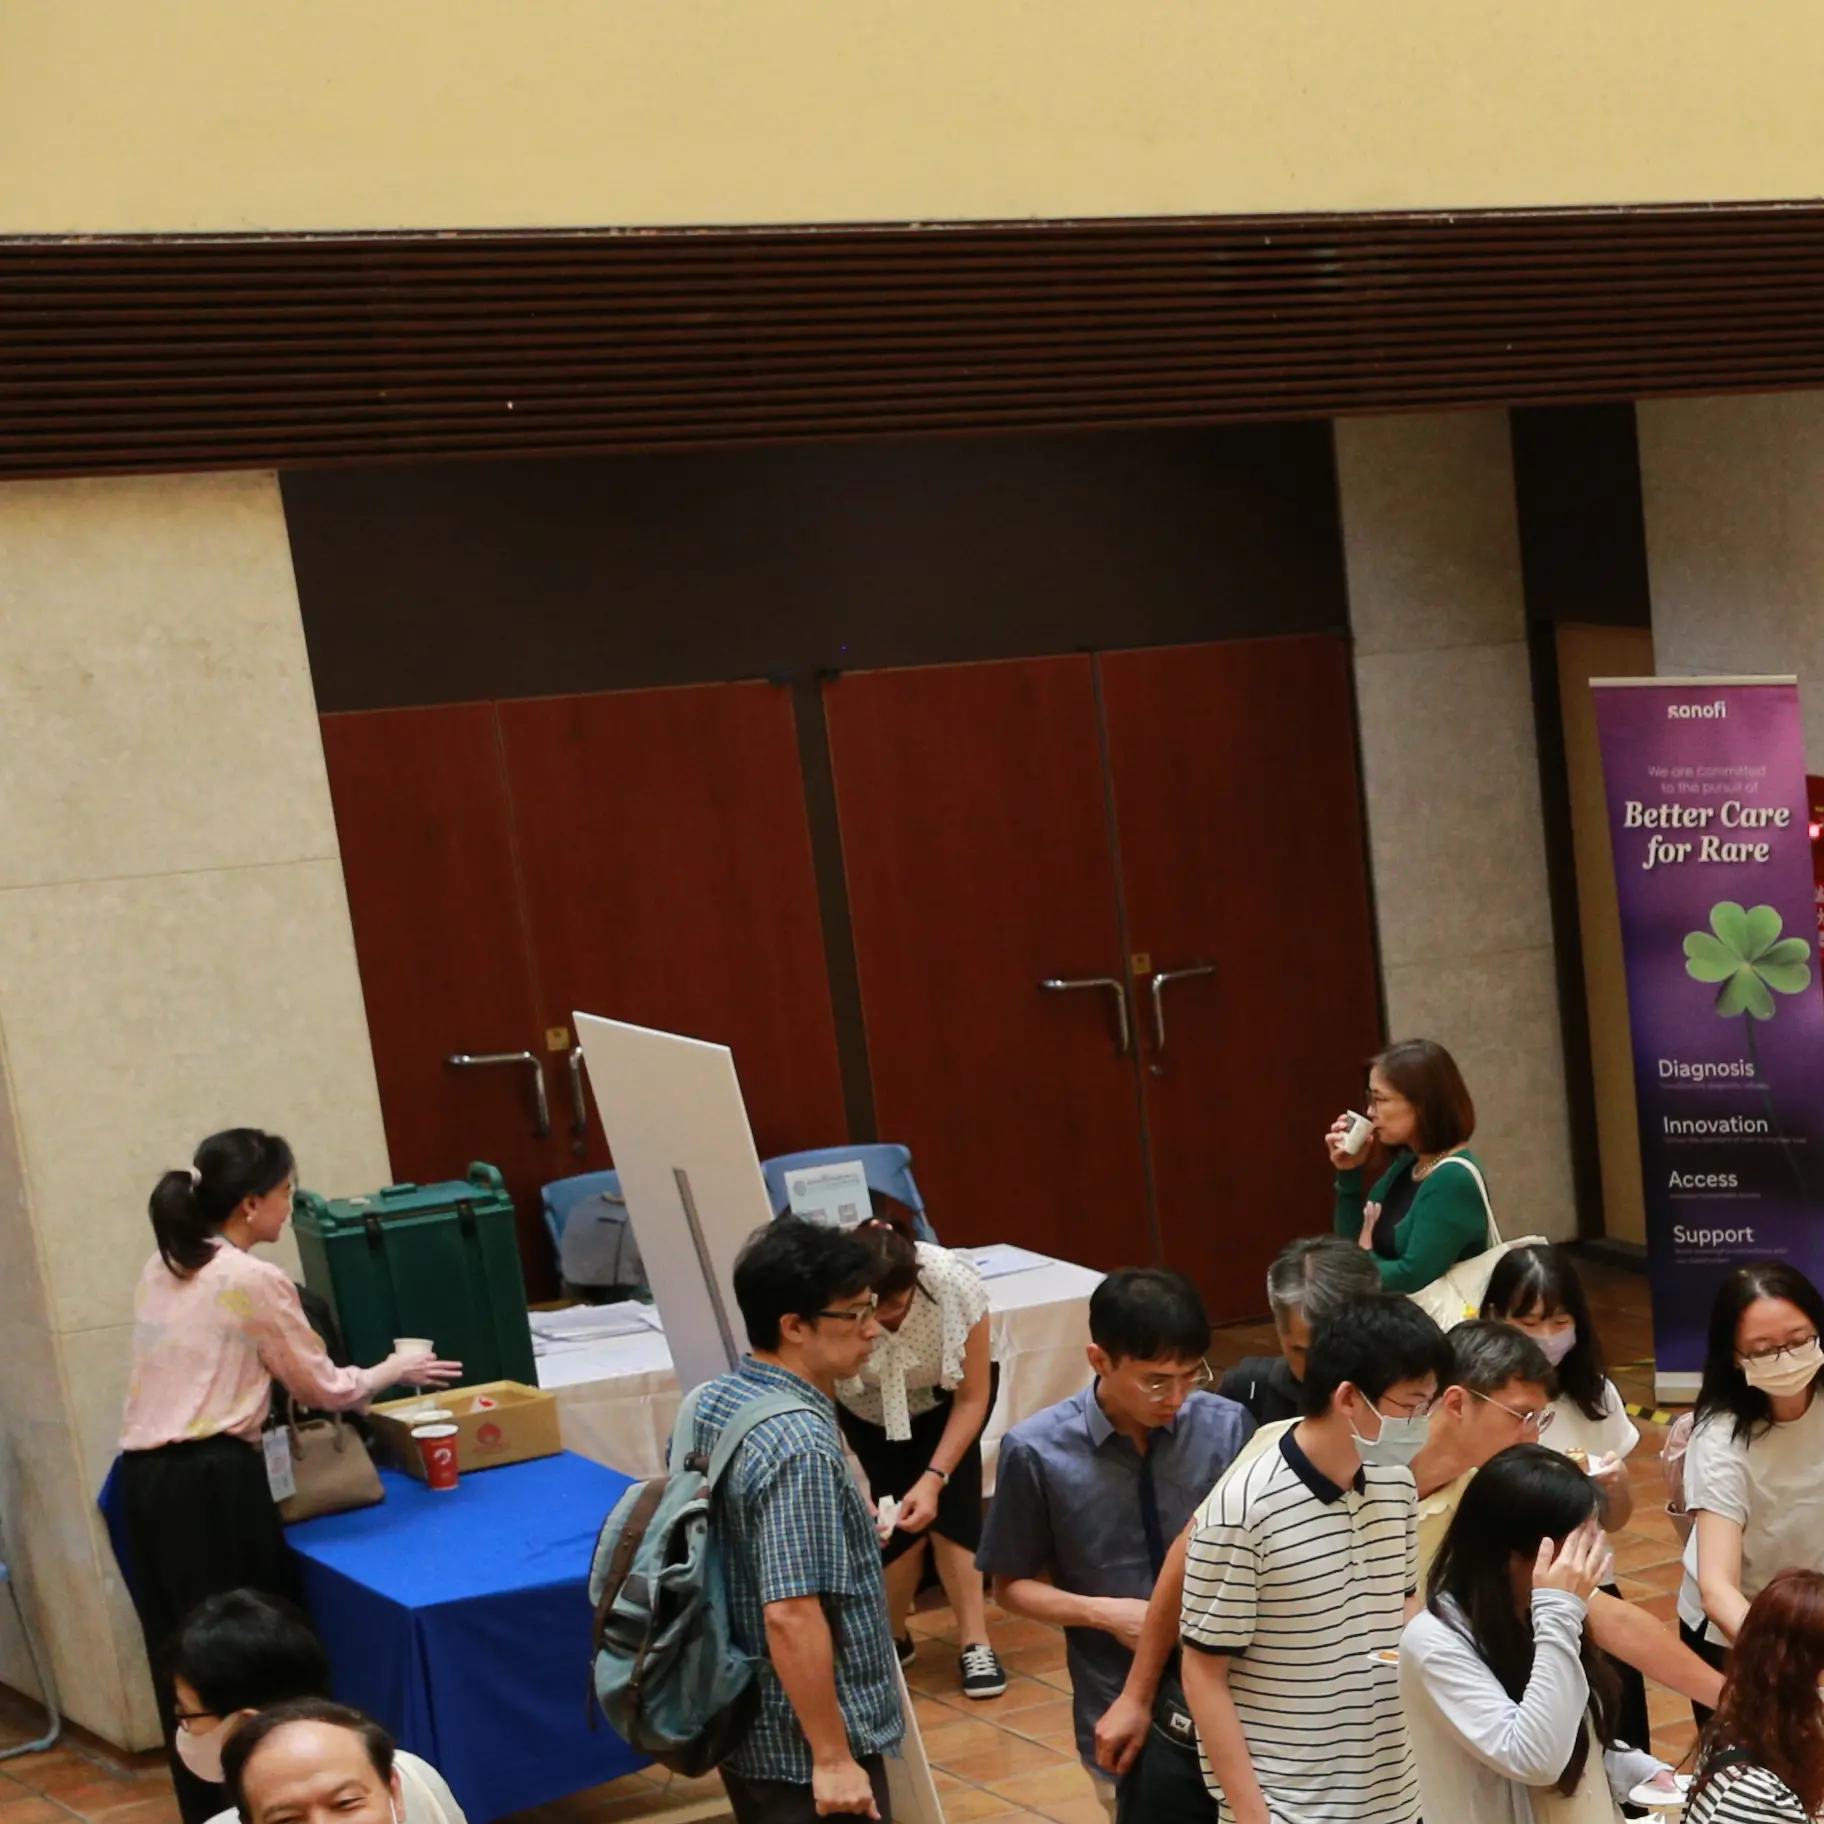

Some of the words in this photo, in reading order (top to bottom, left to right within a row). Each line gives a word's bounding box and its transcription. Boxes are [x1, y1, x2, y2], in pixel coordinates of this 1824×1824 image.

[1667, 700, 1727, 719] sanofi
[1648, 765, 1668, 778] We
[1671, 766, 1694, 778] are
[1697, 765, 1767, 778] committed
[1661, 782, 1675, 795] to
[1679, 781, 1700, 794] the
[1703, 781, 1742, 796] pursuit
[1745, 781, 1759, 794] of
[1623, 800, 1715, 829] Better
[1720, 800, 1791, 829] Care
[1642, 834, 1693, 871] for
[1698, 834, 1771, 863] Rare
[1657, 1058, 1756, 1082] Diagnosis
[1663, 1115, 1769, 1135] Innovation
[1668, 1170, 1738, 1189] Access
[1673, 1224, 1755, 1248] Support
